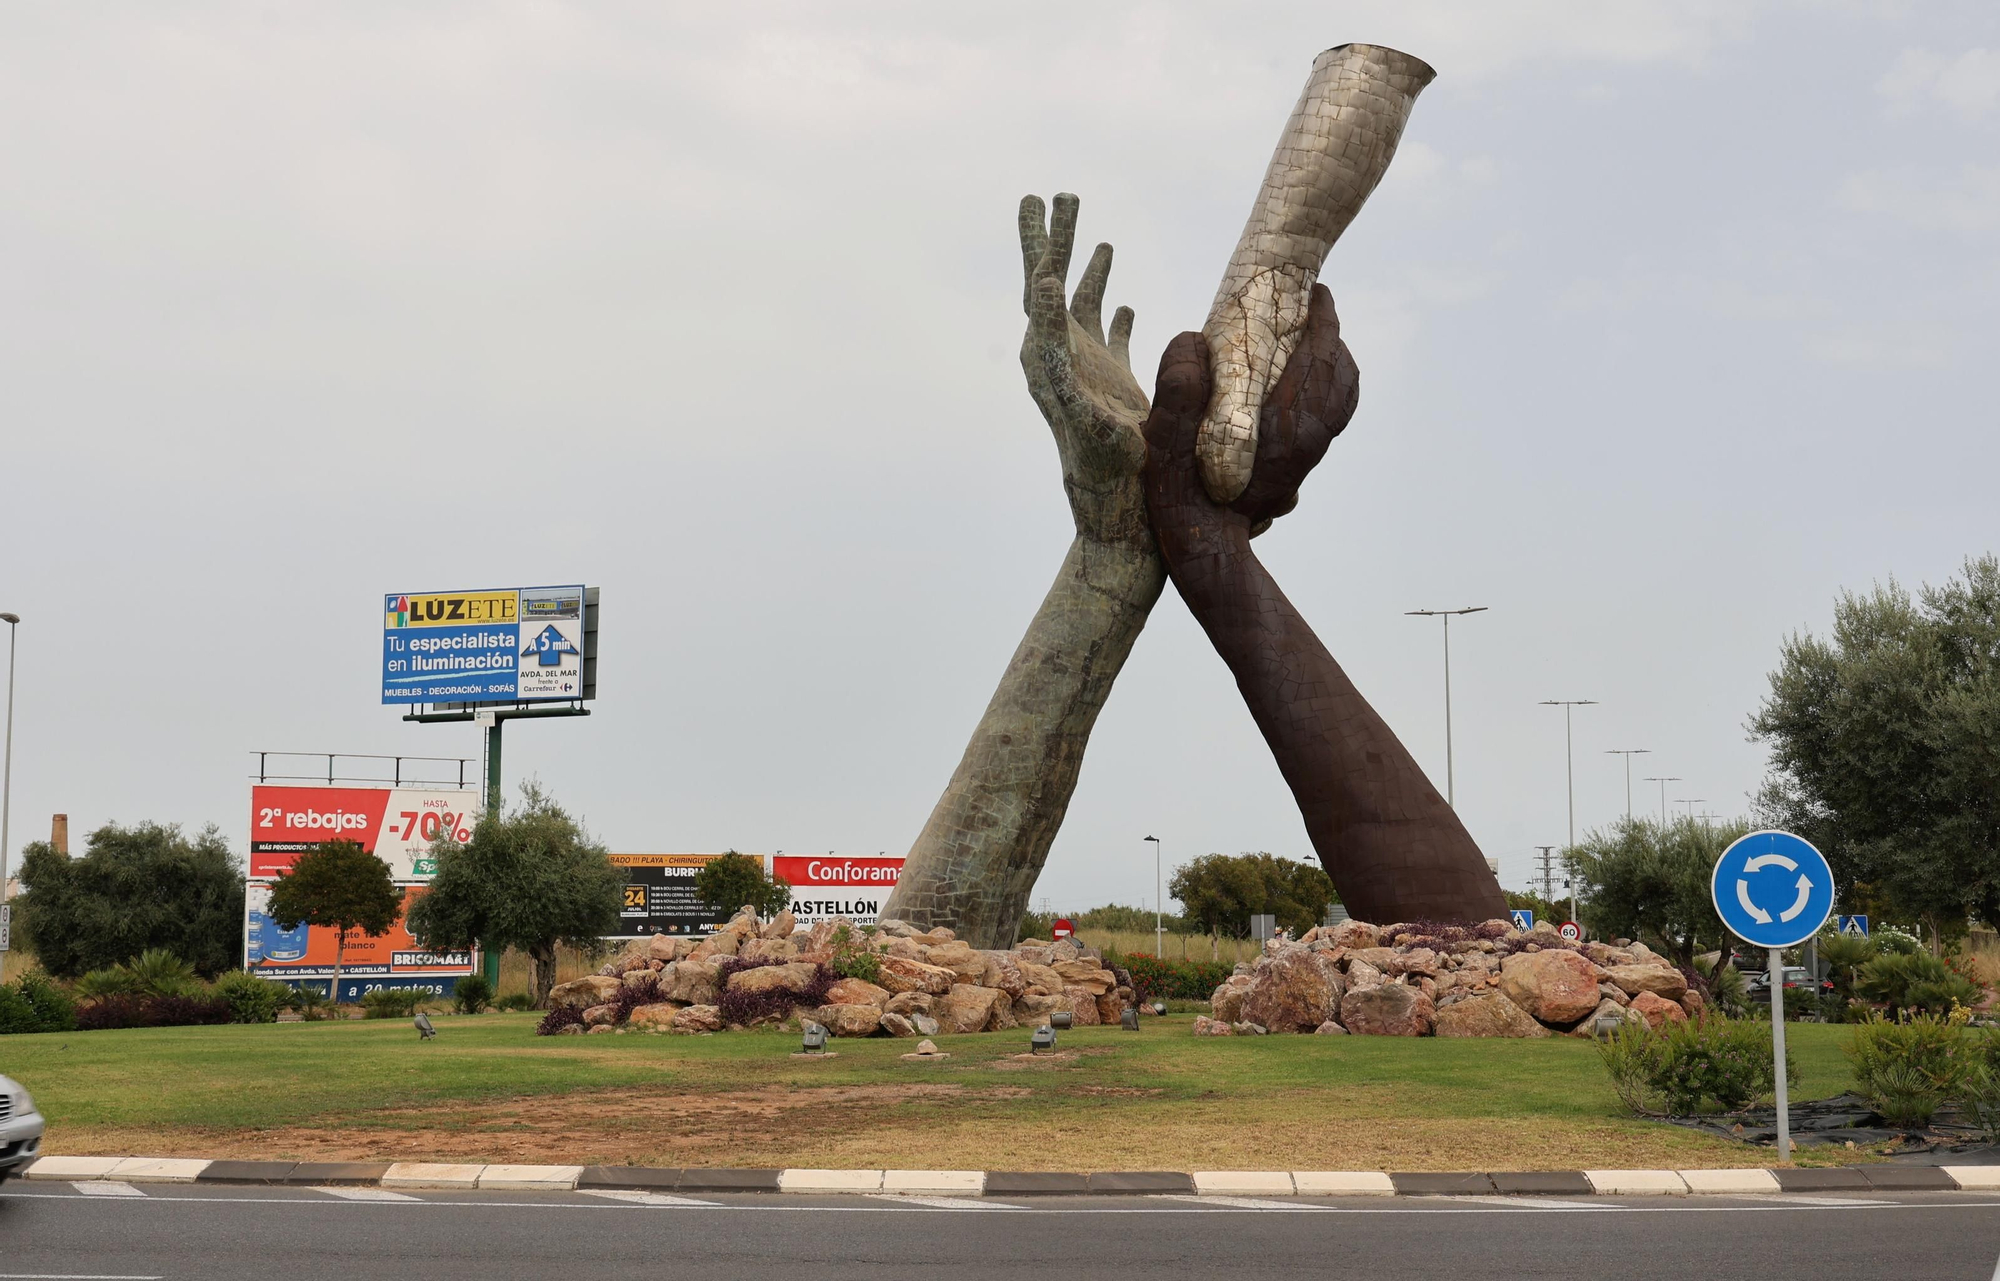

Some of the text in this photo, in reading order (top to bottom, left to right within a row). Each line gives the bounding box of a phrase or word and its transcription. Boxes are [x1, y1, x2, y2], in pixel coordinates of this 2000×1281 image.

[410, 598, 515, 621] LÚZETE
[387, 632, 515, 653] Tu especialista
[529, 632, 571, 651] A 5 min
[388, 652, 513, 671] en iluminación
[384, 688, 422, 696] MUEBLES
[428, 685, 482, 695] DECORACIÓN
[488, 684, 515, 692] SOFÁS
[286, 808, 368, 833] rebajas
[389, 811, 470, 842] -70%
[808, 861, 903, 882] Conforama
[624, 890, 646, 906] 24
[791, 898, 878, 914] ASTELLÓN
[394, 954, 470, 965] BRICOMART
[349, 986, 357, 996] a
